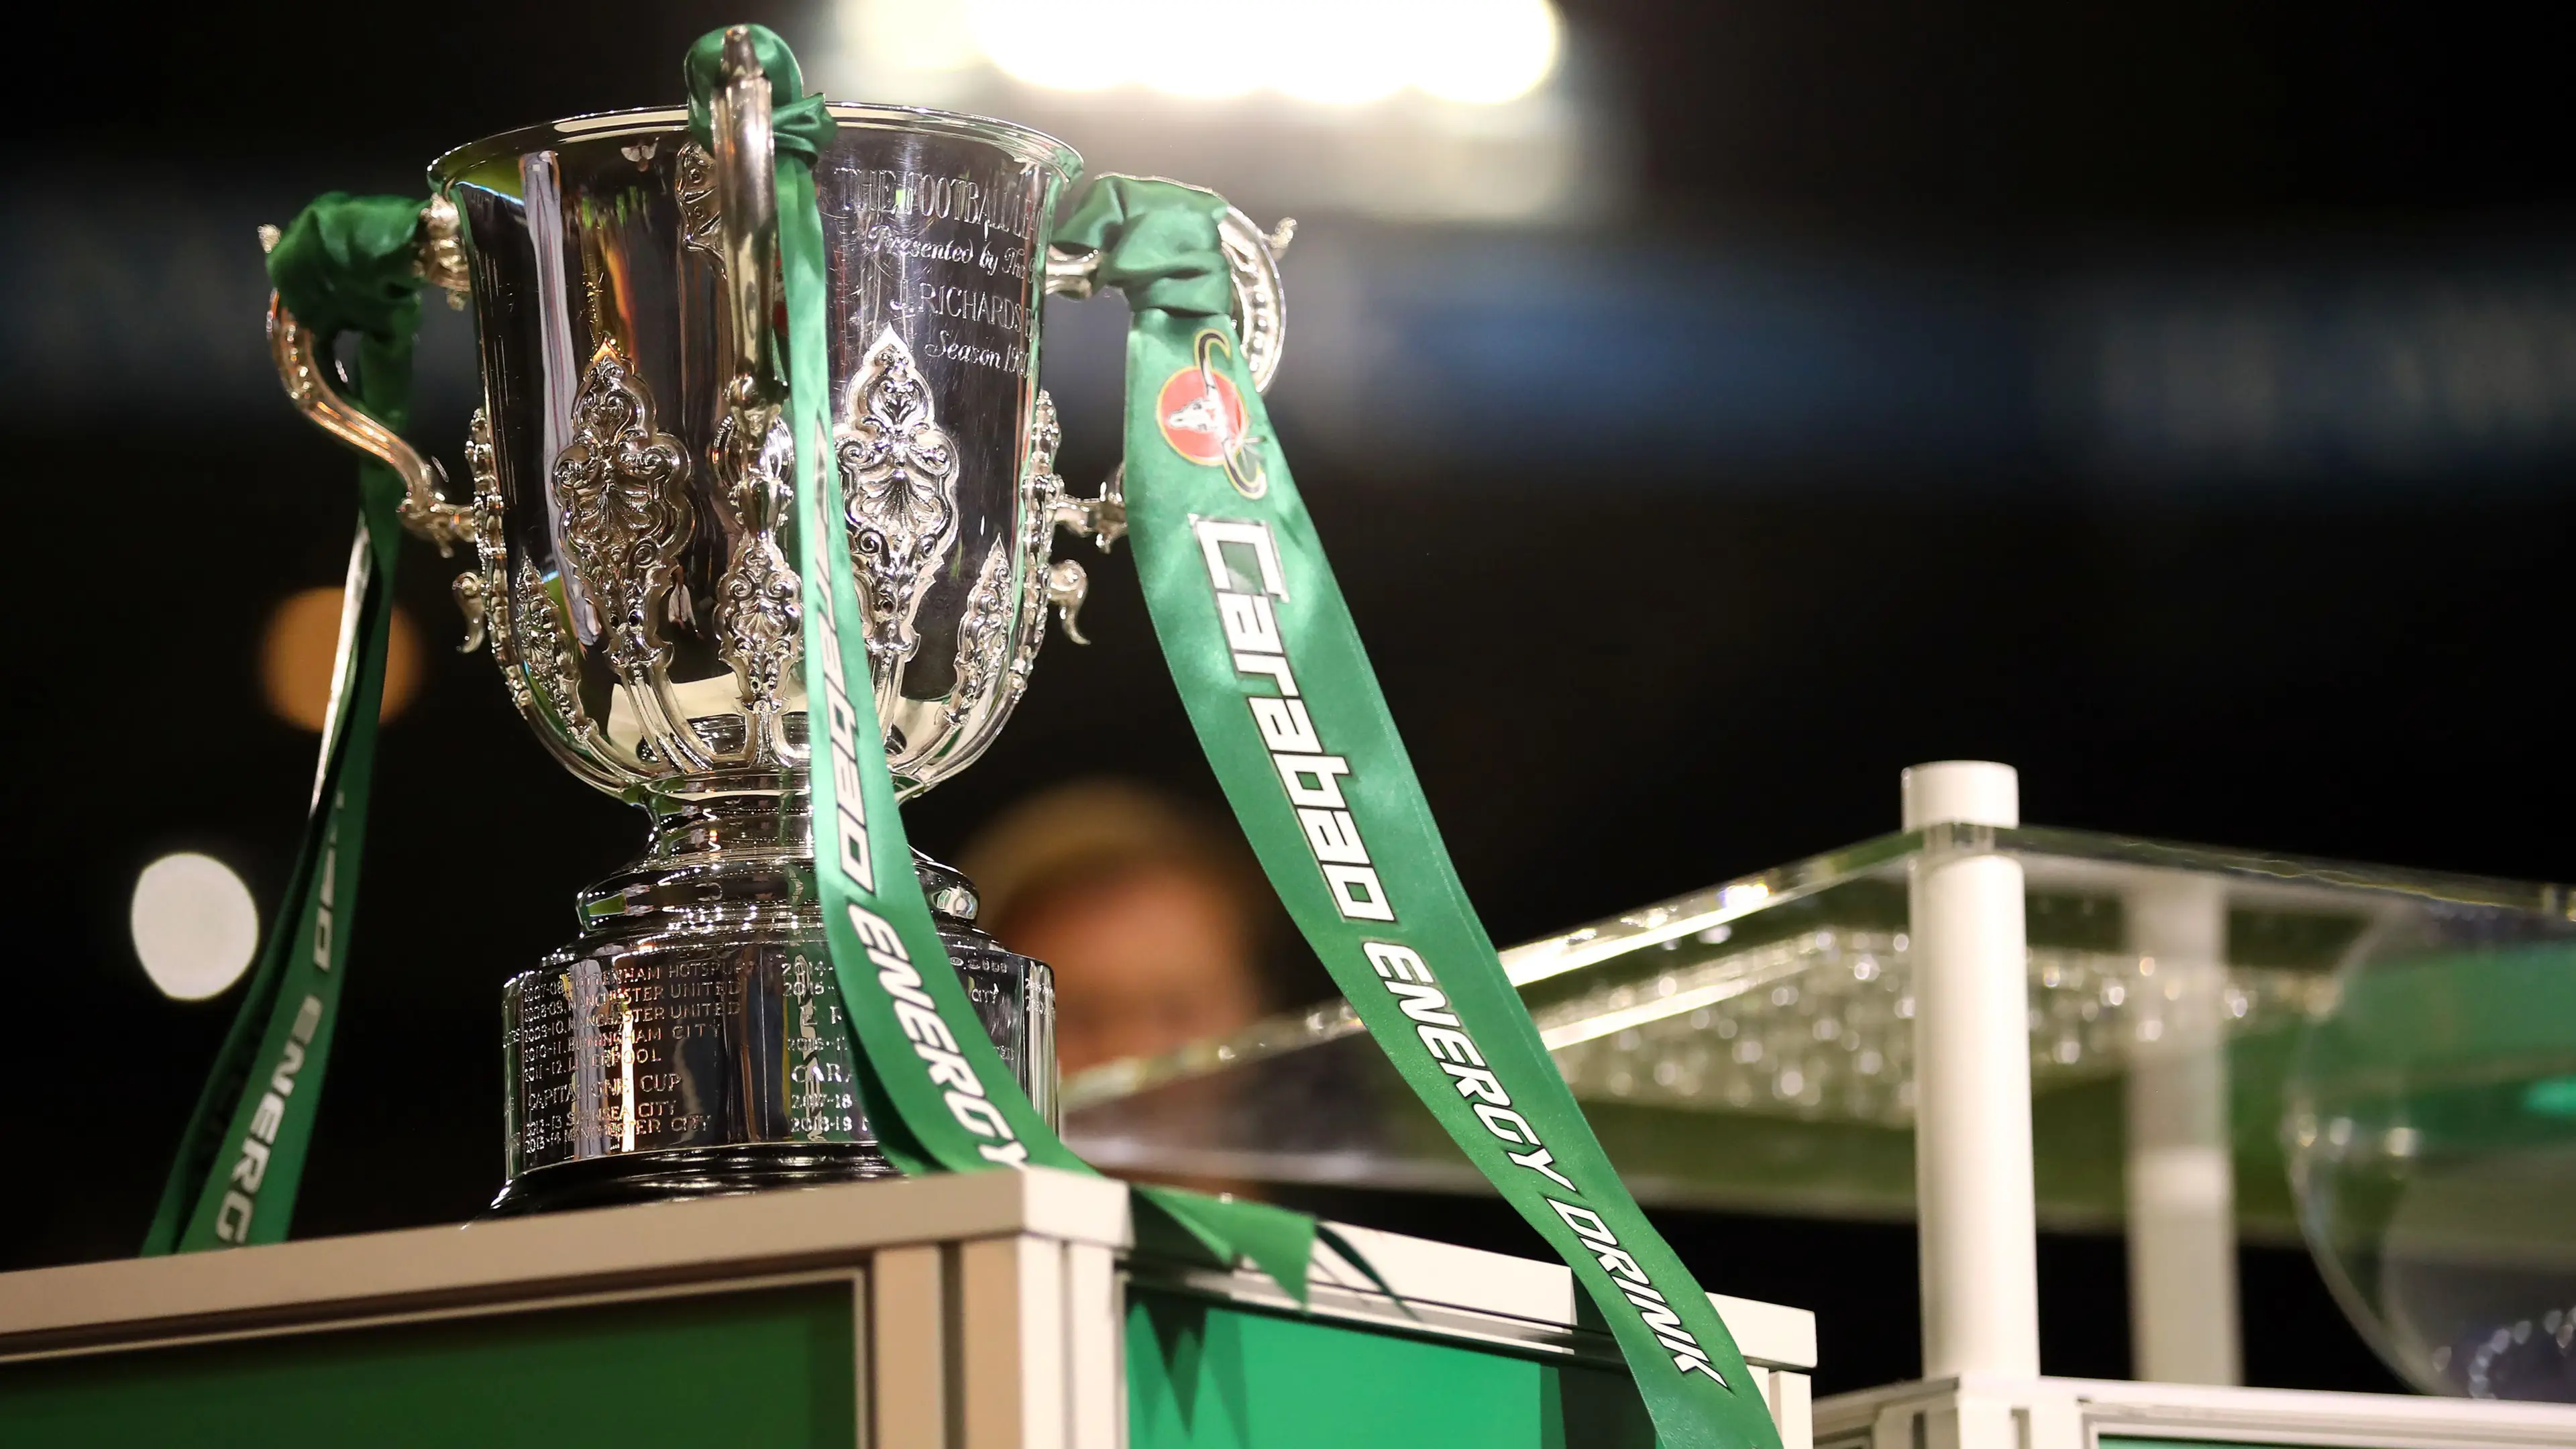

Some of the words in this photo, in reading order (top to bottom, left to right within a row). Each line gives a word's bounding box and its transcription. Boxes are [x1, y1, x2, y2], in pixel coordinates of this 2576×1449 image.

[862, 225, 973, 264] Presented
[979, 239, 999, 276] by
[1002, 247, 1025, 279] The
[924, 329, 1002, 369] Season
[1194, 518, 1396, 922] Carabao
[1362, 941, 1578, 1193] ENERGY
[1546, 1197, 1729, 1391] DRINK
[671, 980, 741, 999] UNITED
[671, 1002, 741, 1019] UNITED
[672, 1023, 720, 1040] CITY
[847, 904, 1028, 1169] ENERGY
[640, 1073, 682, 1093] CUP
[638, 1100, 677, 1118] CITY
[671, 1114, 711, 1132] CITY
